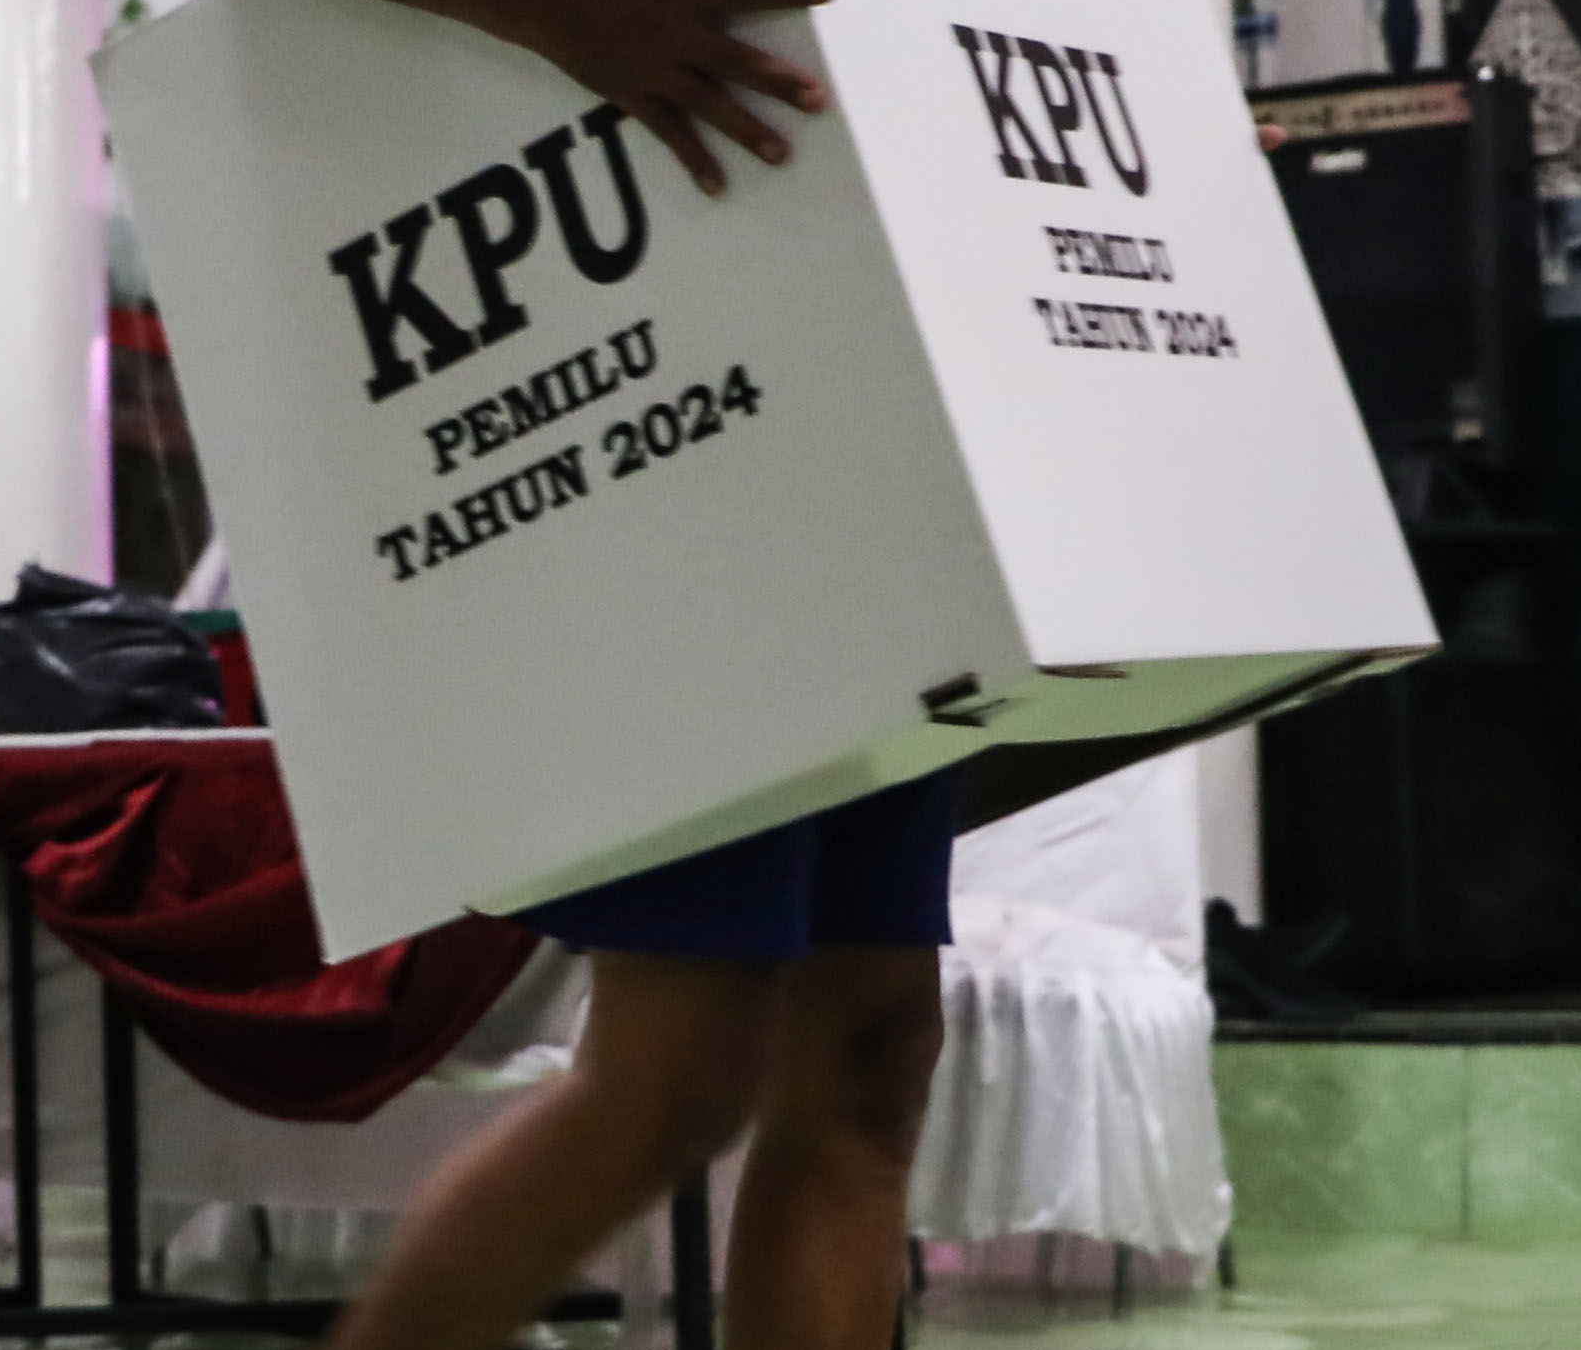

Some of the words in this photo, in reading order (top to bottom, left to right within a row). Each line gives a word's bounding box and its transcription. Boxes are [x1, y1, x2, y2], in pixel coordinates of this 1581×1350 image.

[952, 24, 1148, 197] KPU
[328, 97, 649, 403] KPU
[1033, 297, 1151, 352] TAHUN
[1155, 309, 1236, 358] 2024
[1044, 226, 1173, 283] PEMILU
[377, 445, 588, 581] TAHUN
[603, 366, 761, 479] 2024
[425, 319, 656, 475] PEMILU
